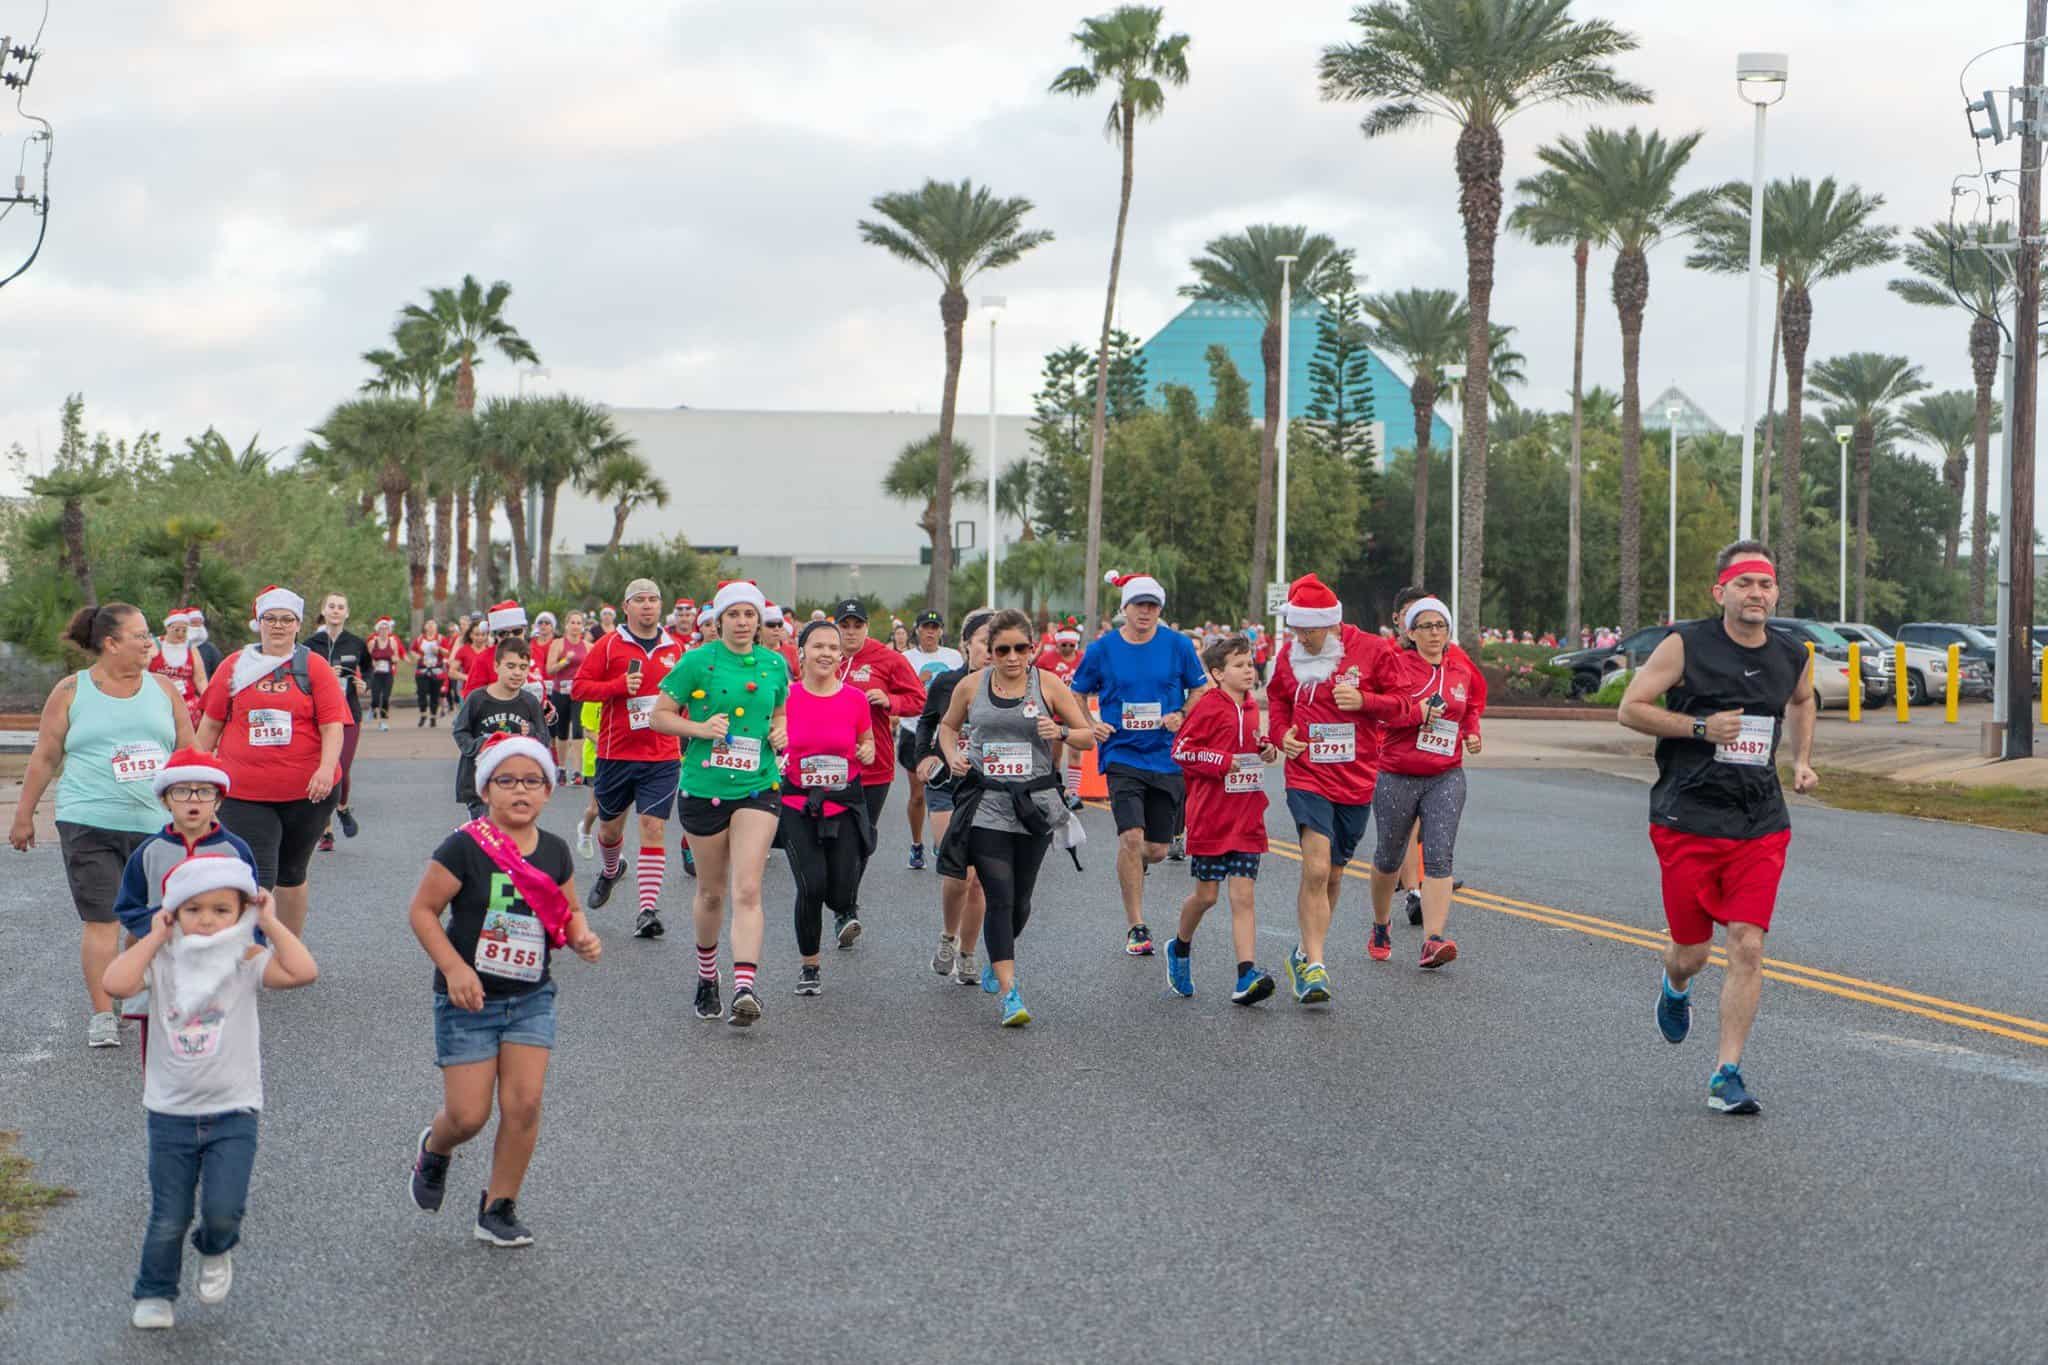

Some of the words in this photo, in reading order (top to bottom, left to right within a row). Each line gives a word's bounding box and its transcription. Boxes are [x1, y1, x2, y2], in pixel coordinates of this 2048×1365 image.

[1126, 720, 1154, 729] 8259
[254, 727, 283, 738] 8154
[1422, 734, 1449, 748] 8793
[1313, 744, 1346, 754] 8791
[120, 759, 156, 773] 8153
[715, 755, 752, 769] 8434
[988, 763, 1024, 774] 9318
[806, 774, 840, 785] 9319
[1229, 773, 1259, 784] 8792
[485, 943, 537, 967] 8155
